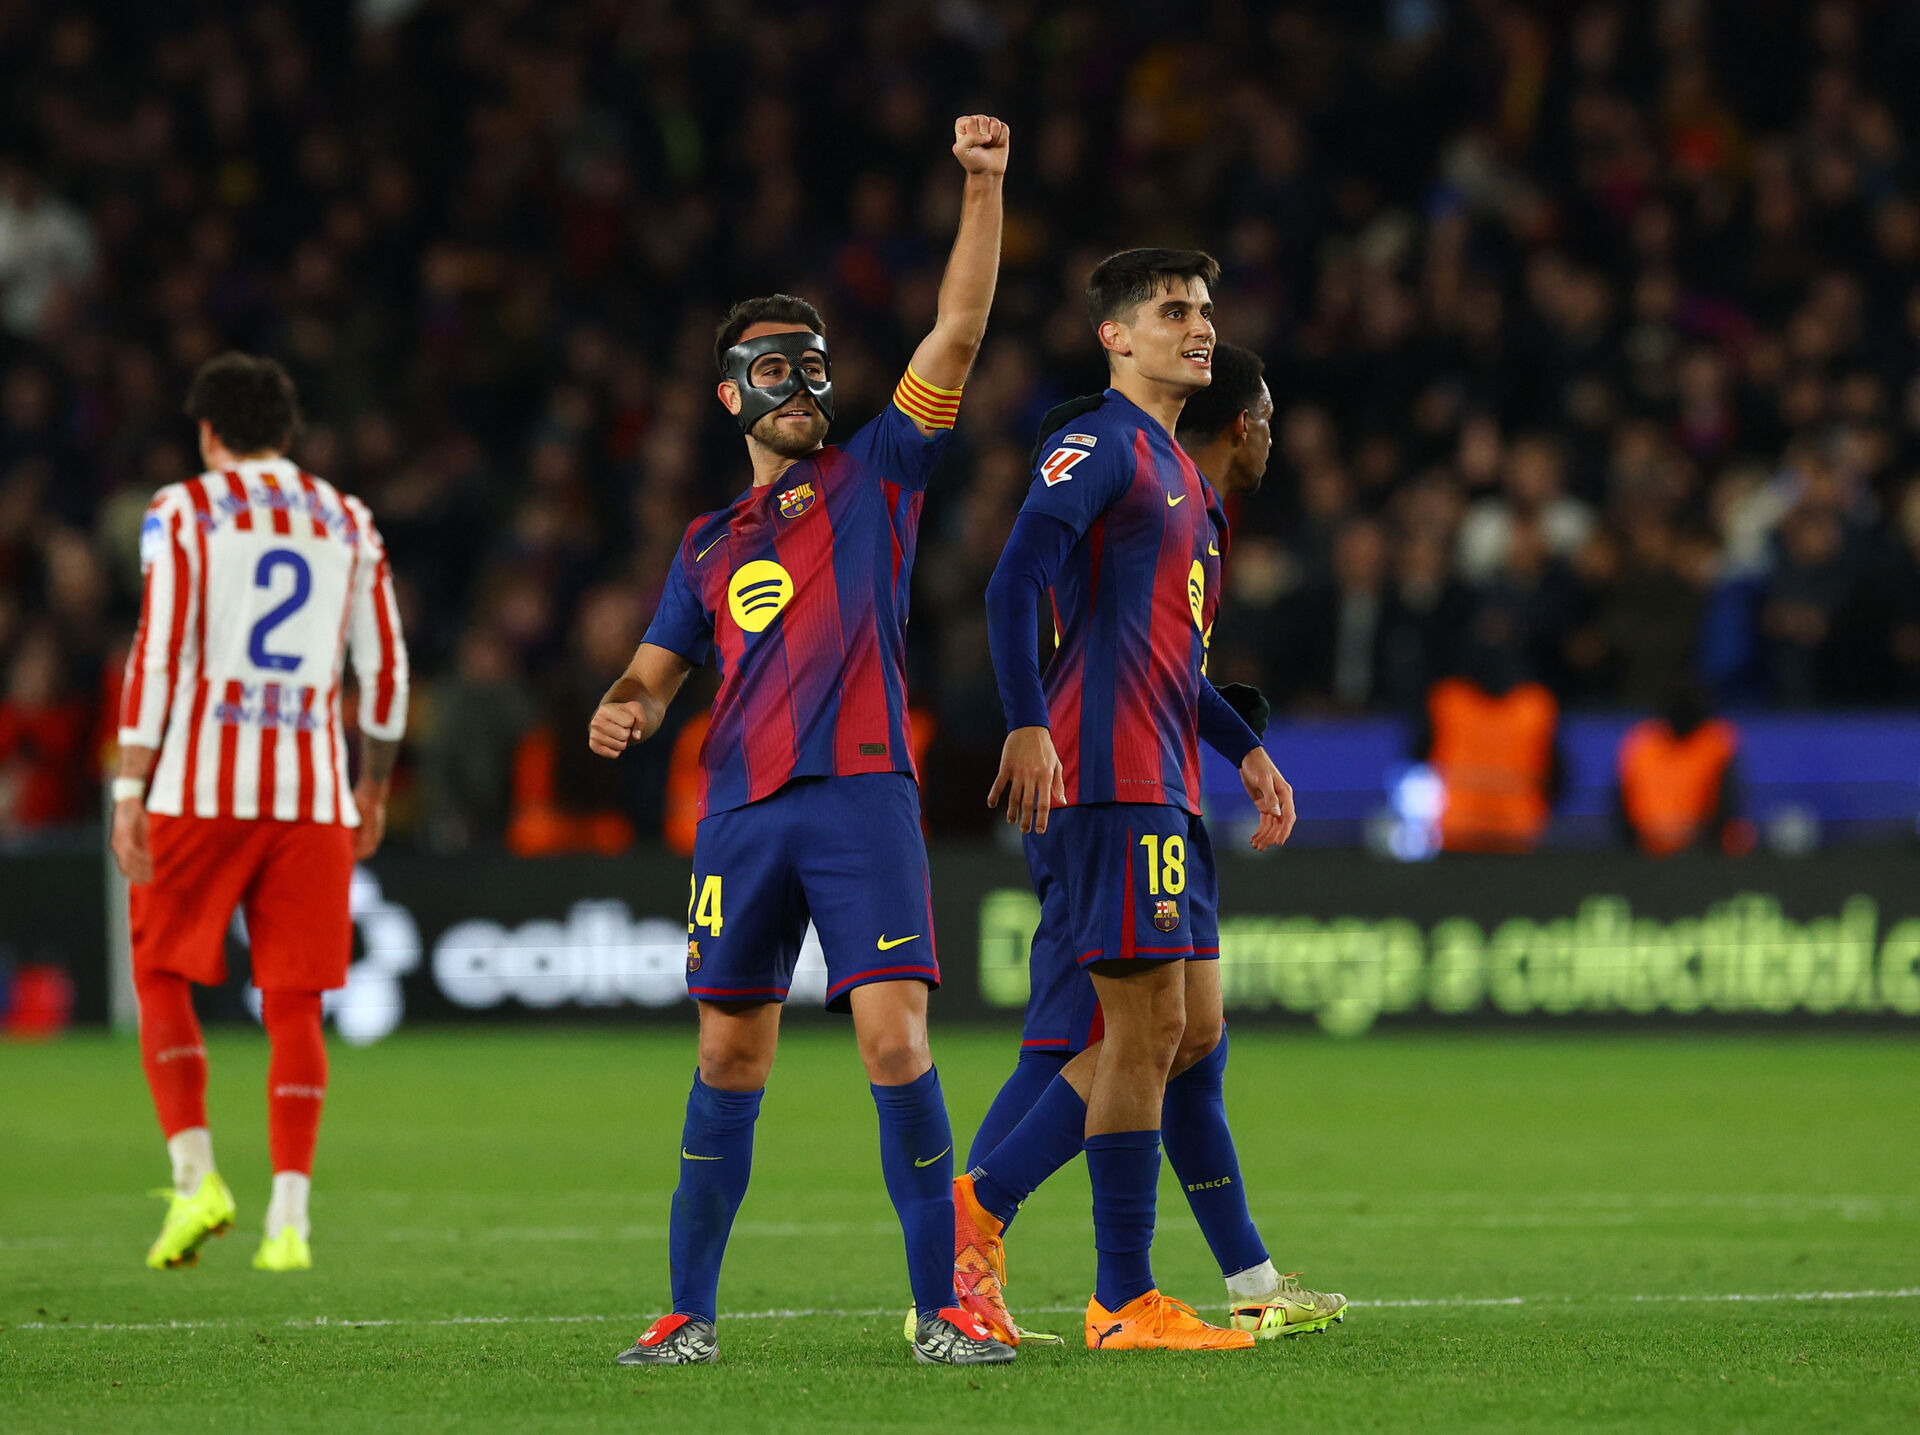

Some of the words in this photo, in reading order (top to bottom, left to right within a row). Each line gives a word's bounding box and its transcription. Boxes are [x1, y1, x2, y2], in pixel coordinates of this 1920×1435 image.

[248, 549, 311, 673] 2
[1139, 834, 1186, 895] 18
[1187, 1176, 1232, 1192] BARÇA
